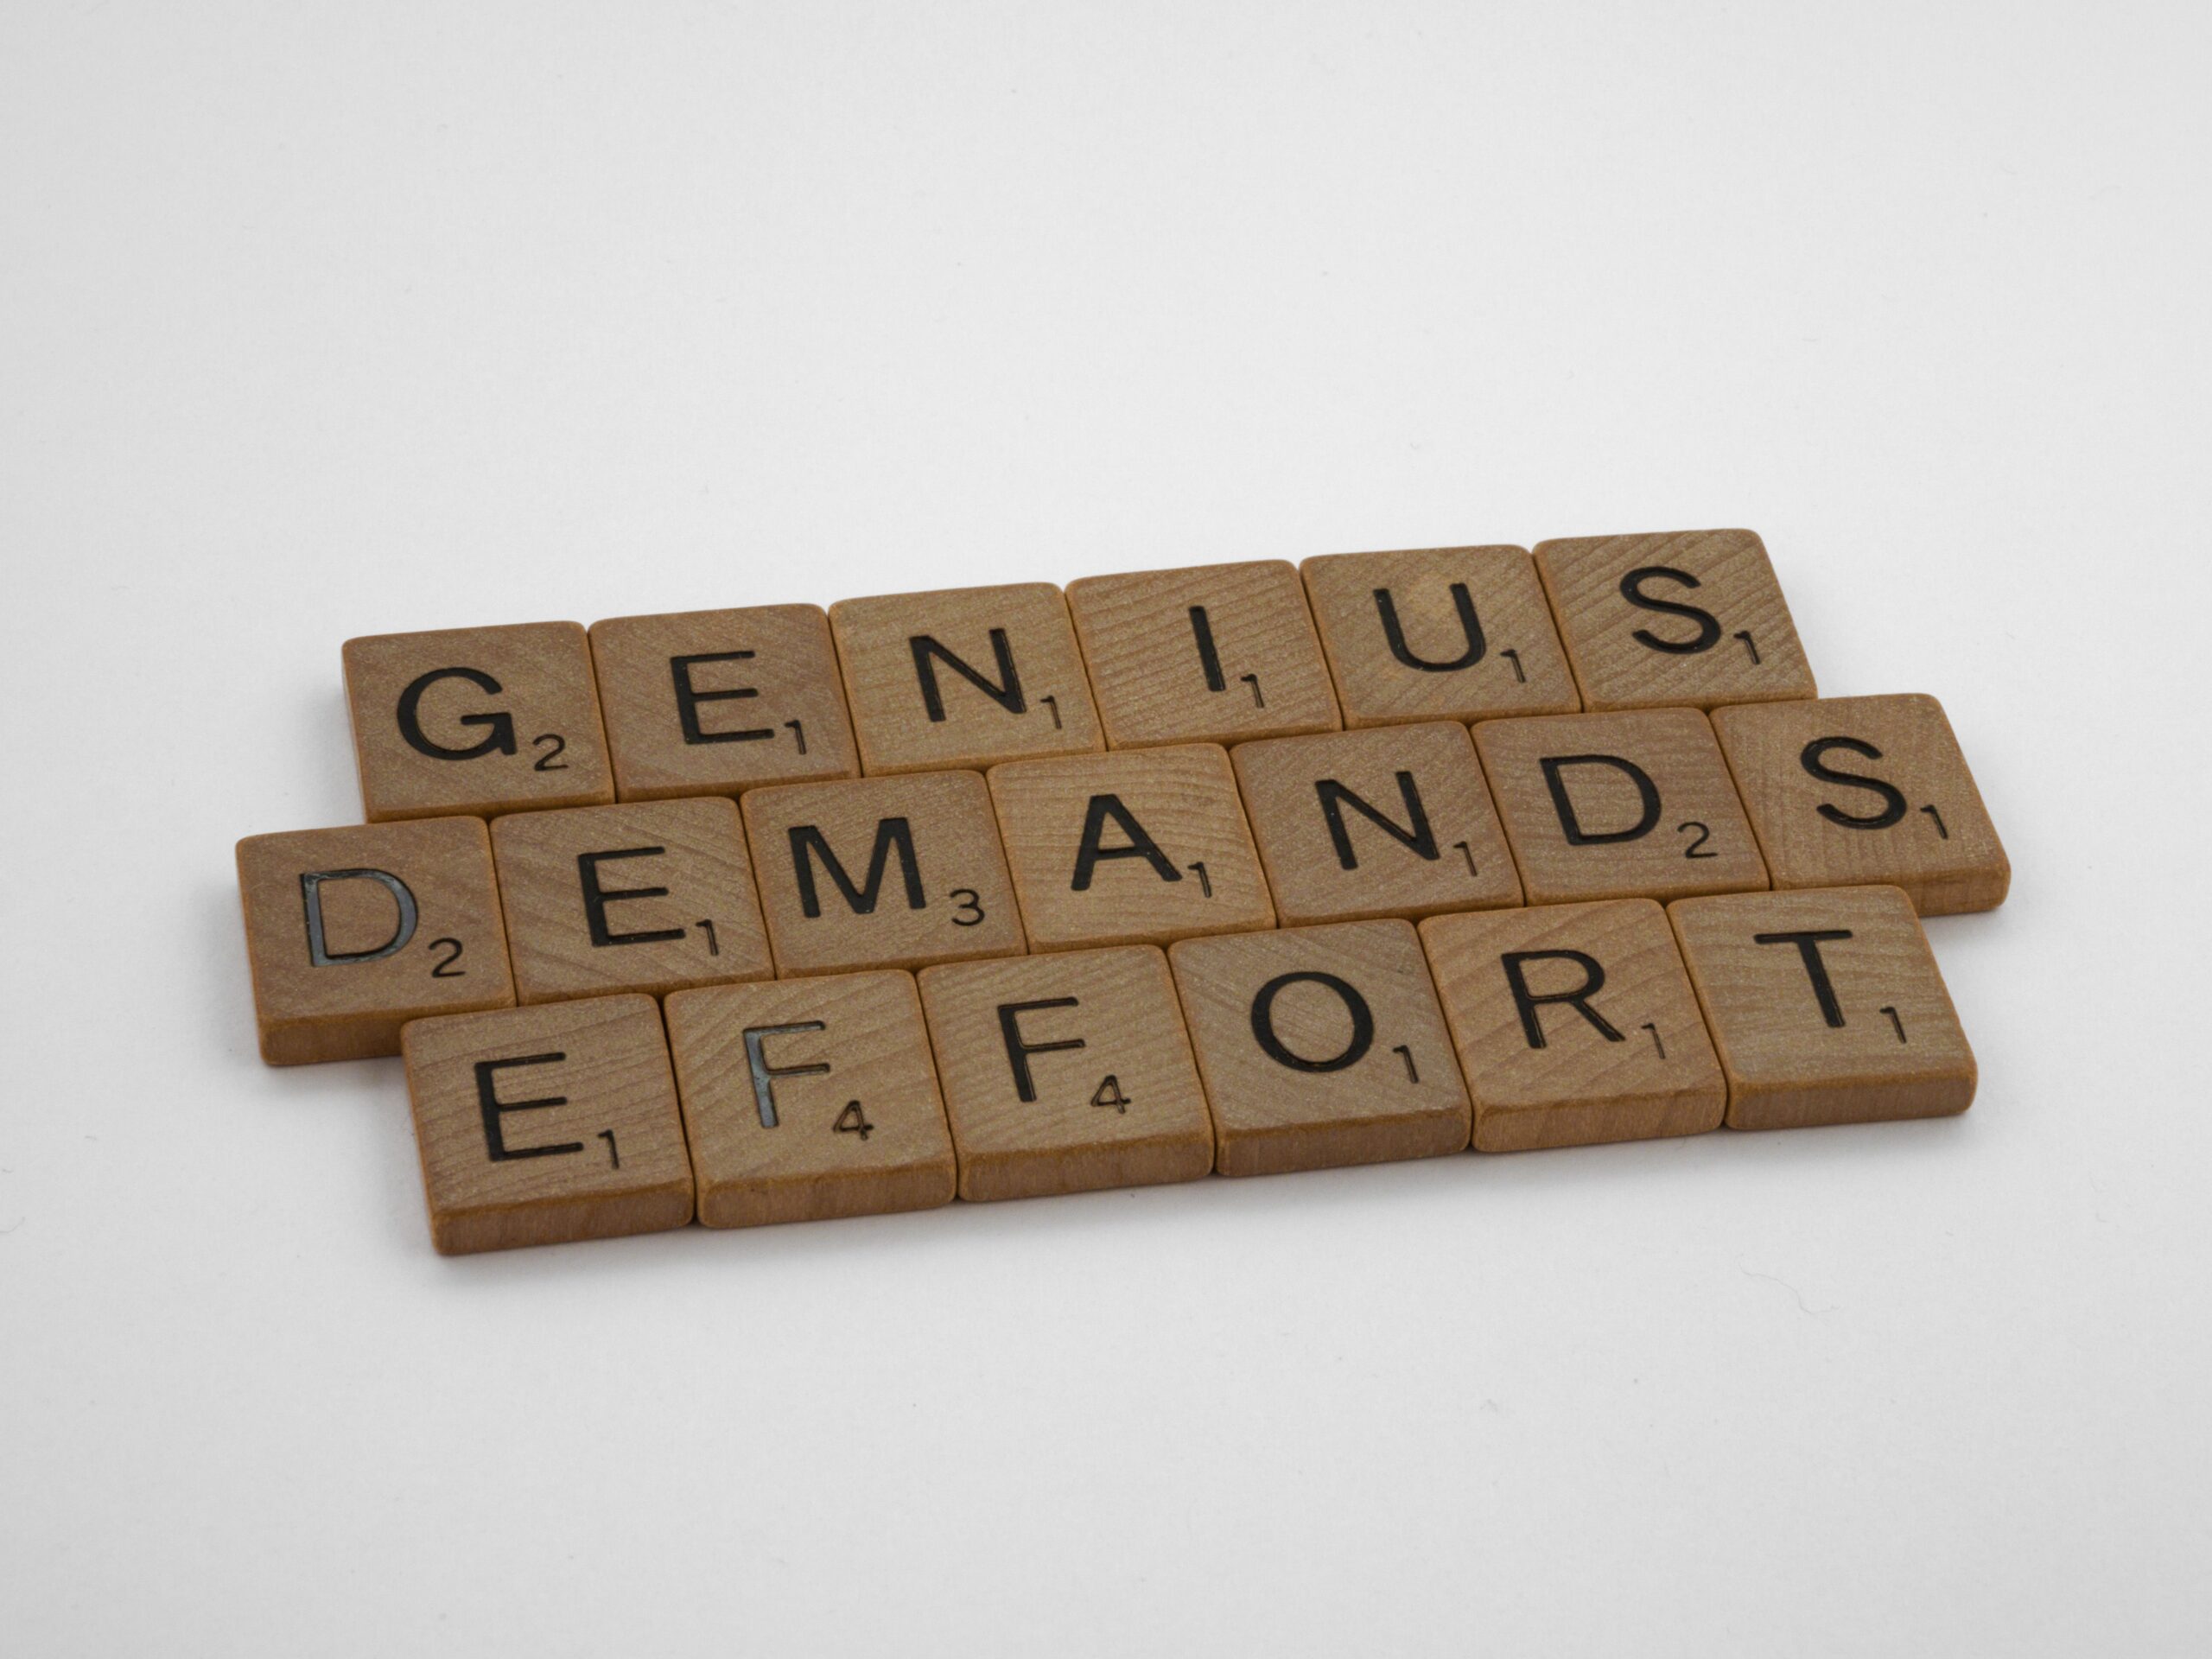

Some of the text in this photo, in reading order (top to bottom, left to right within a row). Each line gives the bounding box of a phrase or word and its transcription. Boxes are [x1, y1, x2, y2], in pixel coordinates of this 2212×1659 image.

[394, 563, 1726, 763] GENIUS
[1498, 646, 1529, 685] 1
[1732, 628, 1765, 667] 1
[1238, 671, 1268, 710] 1
[1038, 693, 1065, 732] 1
[531, 732, 571, 773] 2
[782, 717, 809, 757] 1
[1675, 819, 1720, 861] 2
[1918, 803, 1951, 842] 1
[296, 734, 1910, 969] DEMANDS
[1451, 839, 1480, 879] 1
[1185, 860, 1214, 900] 1
[946, 887, 987, 929] 3
[426, 936, 467, 980] 2
[693, 917, 721, 958] 1
[1639, 1020, 1668, 1061] 1
[1878, 1004, 1909, 1046] 1
[471, 927, 1856, 1165] EFFORT
[1390, 1043, 1421, 1085] 1
[1088, 1072, 1134, 1116] 4
[830, 1097, 876, 1143] 4
[595, 1128, 622, 1172] 1
